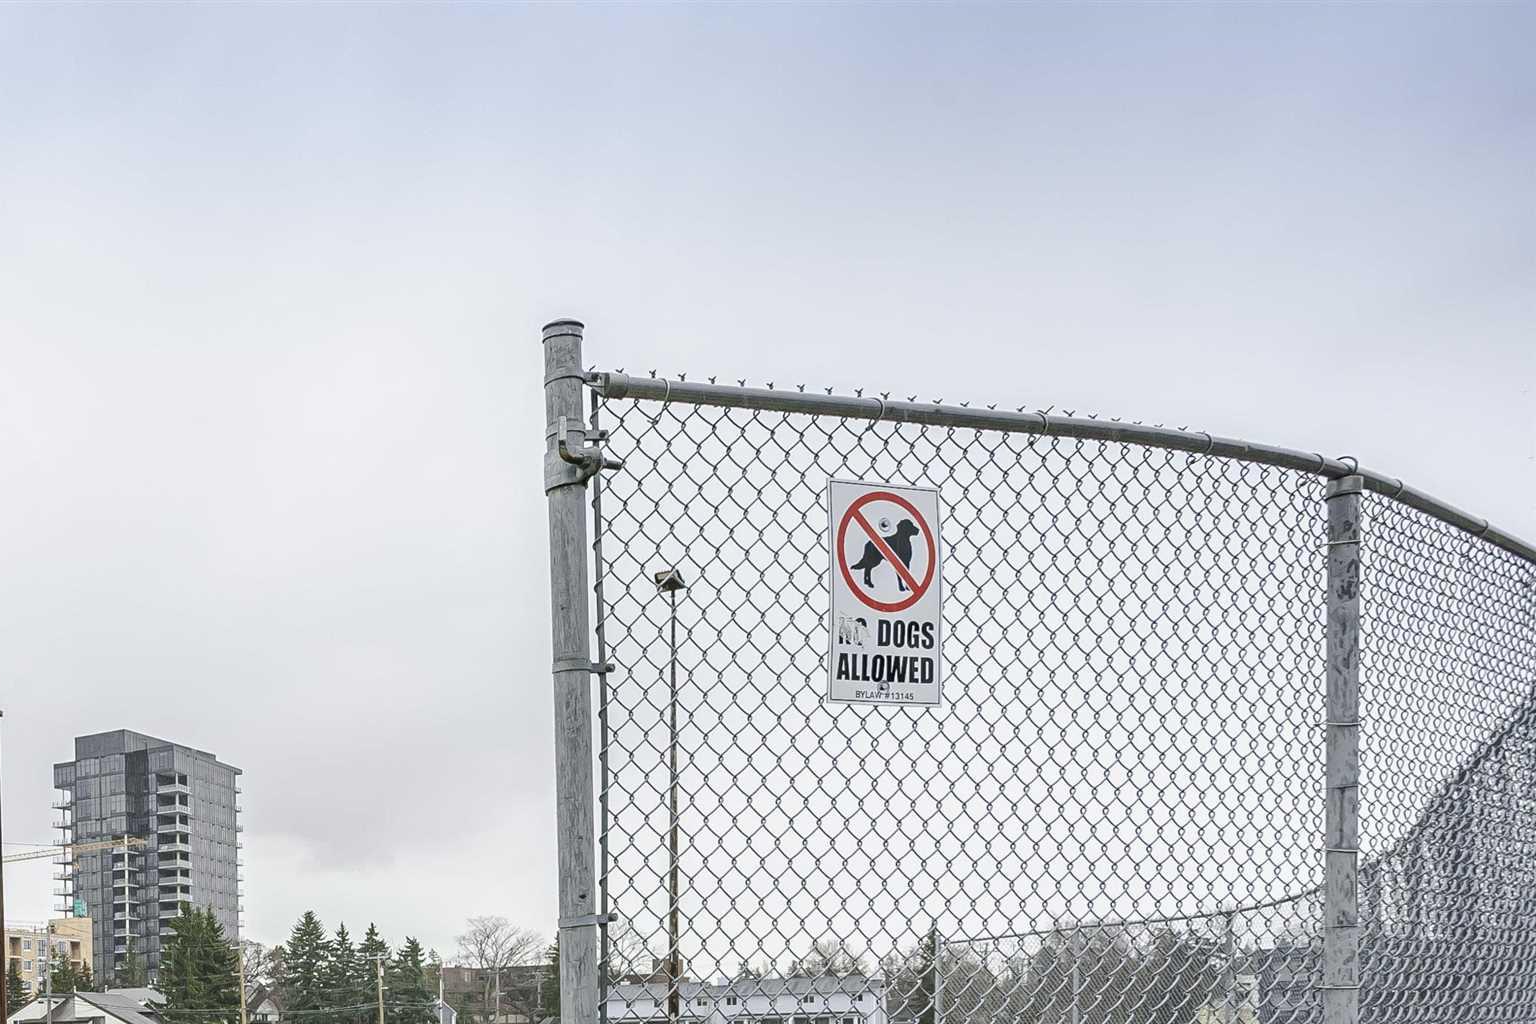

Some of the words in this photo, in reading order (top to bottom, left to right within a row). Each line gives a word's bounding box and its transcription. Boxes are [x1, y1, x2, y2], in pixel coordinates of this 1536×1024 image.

[877, 619, 934, 649] DOGS
[836, 653, 934, 684] ALLOWED
[855, 690, 882, 699] BYLAW
